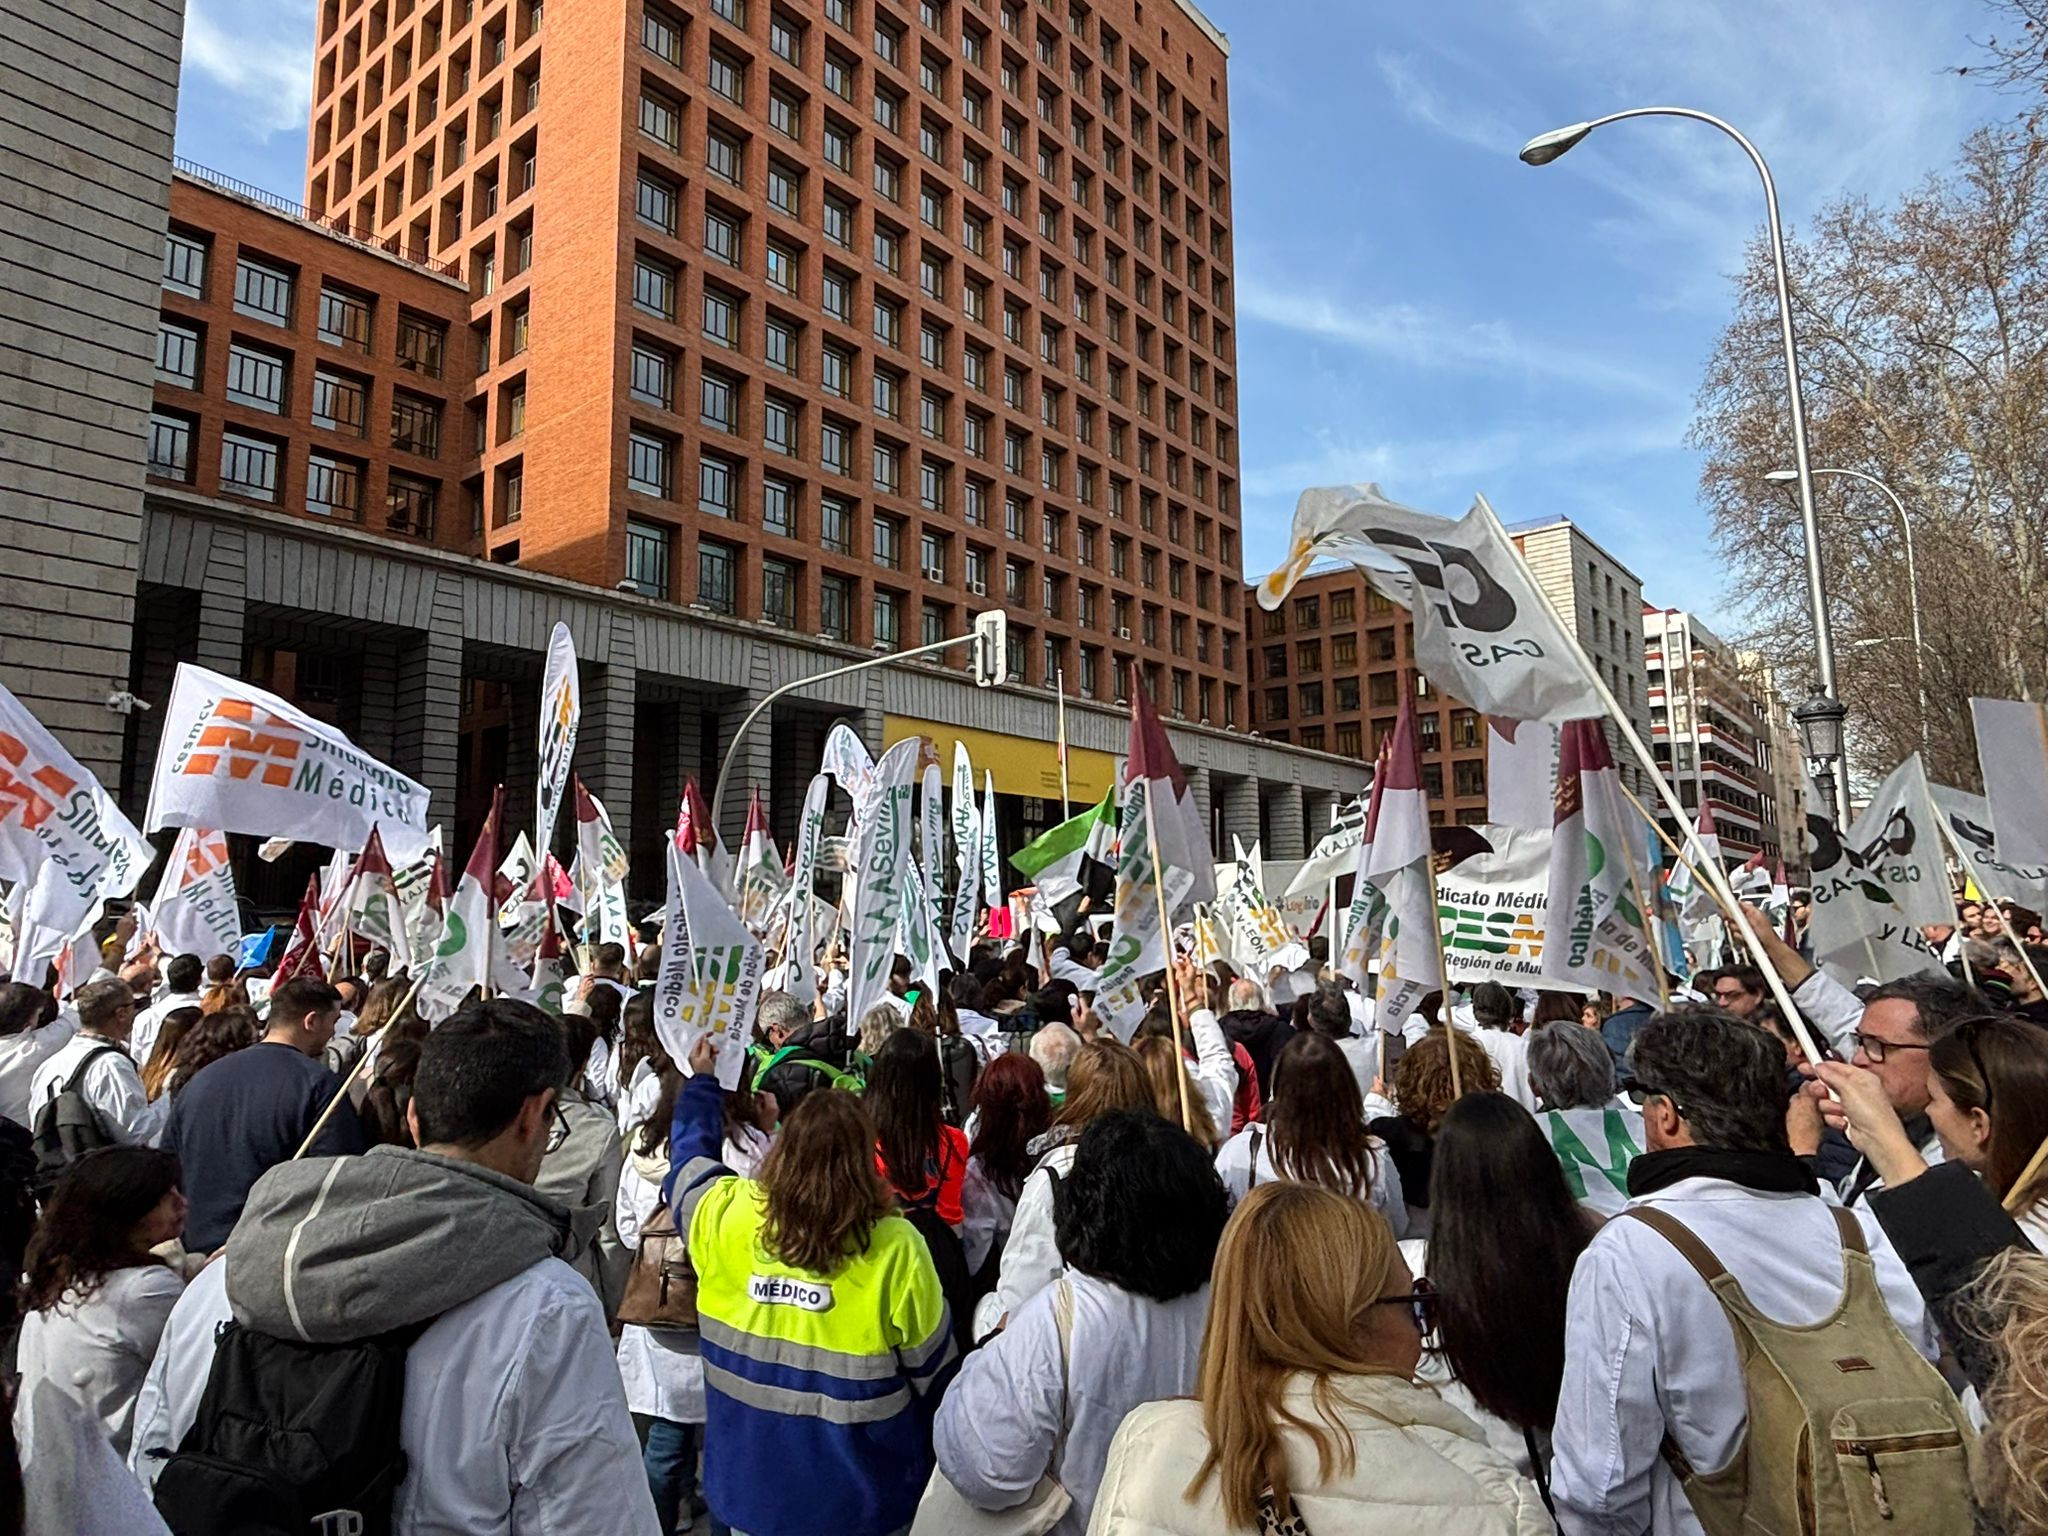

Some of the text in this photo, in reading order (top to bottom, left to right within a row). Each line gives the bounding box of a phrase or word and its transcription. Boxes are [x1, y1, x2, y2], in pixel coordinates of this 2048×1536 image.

[294, 758, 410, 826] Médico
[1435, 886, 1490, 907] dicato
[182, 880, 242, 954] Médico
[1494, 957, 1513, 972] de
[753, 1278, 821, 1305] MÉDICO
